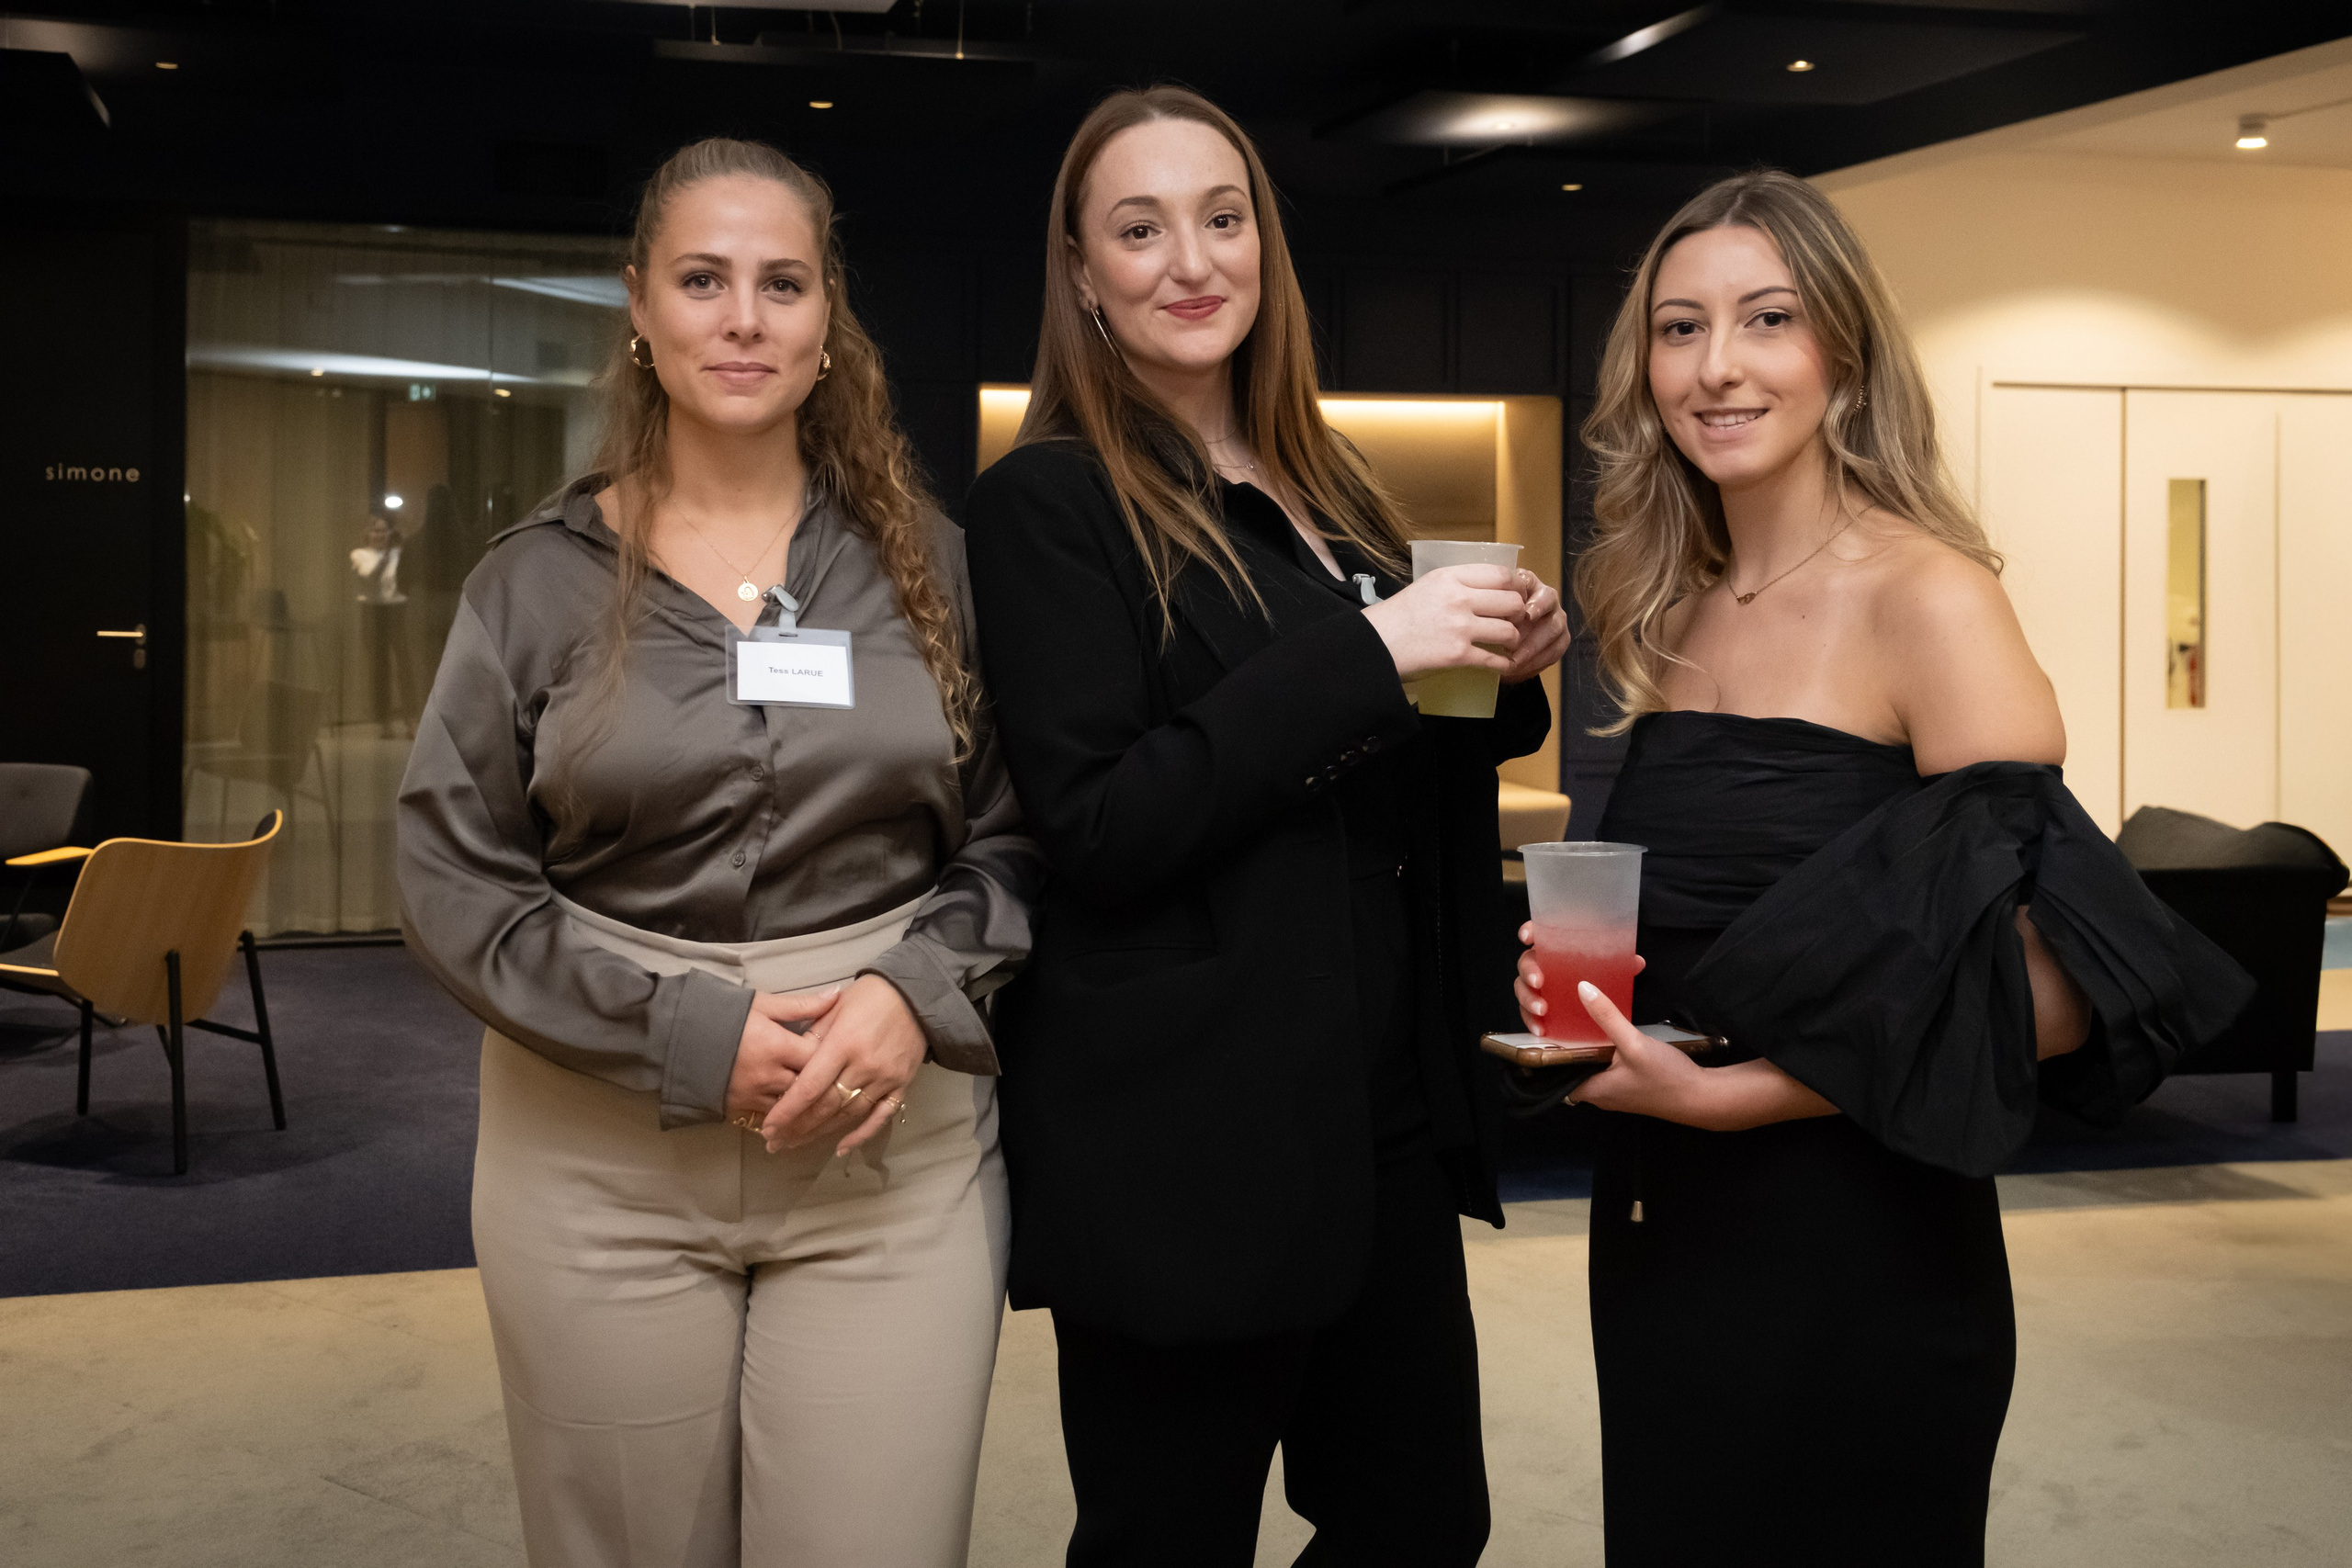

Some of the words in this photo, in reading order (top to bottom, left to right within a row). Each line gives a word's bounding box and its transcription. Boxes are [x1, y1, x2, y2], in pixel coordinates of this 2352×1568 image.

[46, 462, 141, 482] simone
[769, 666, 789, 674] Tess
[791, 669, 824, 677] LARUE
